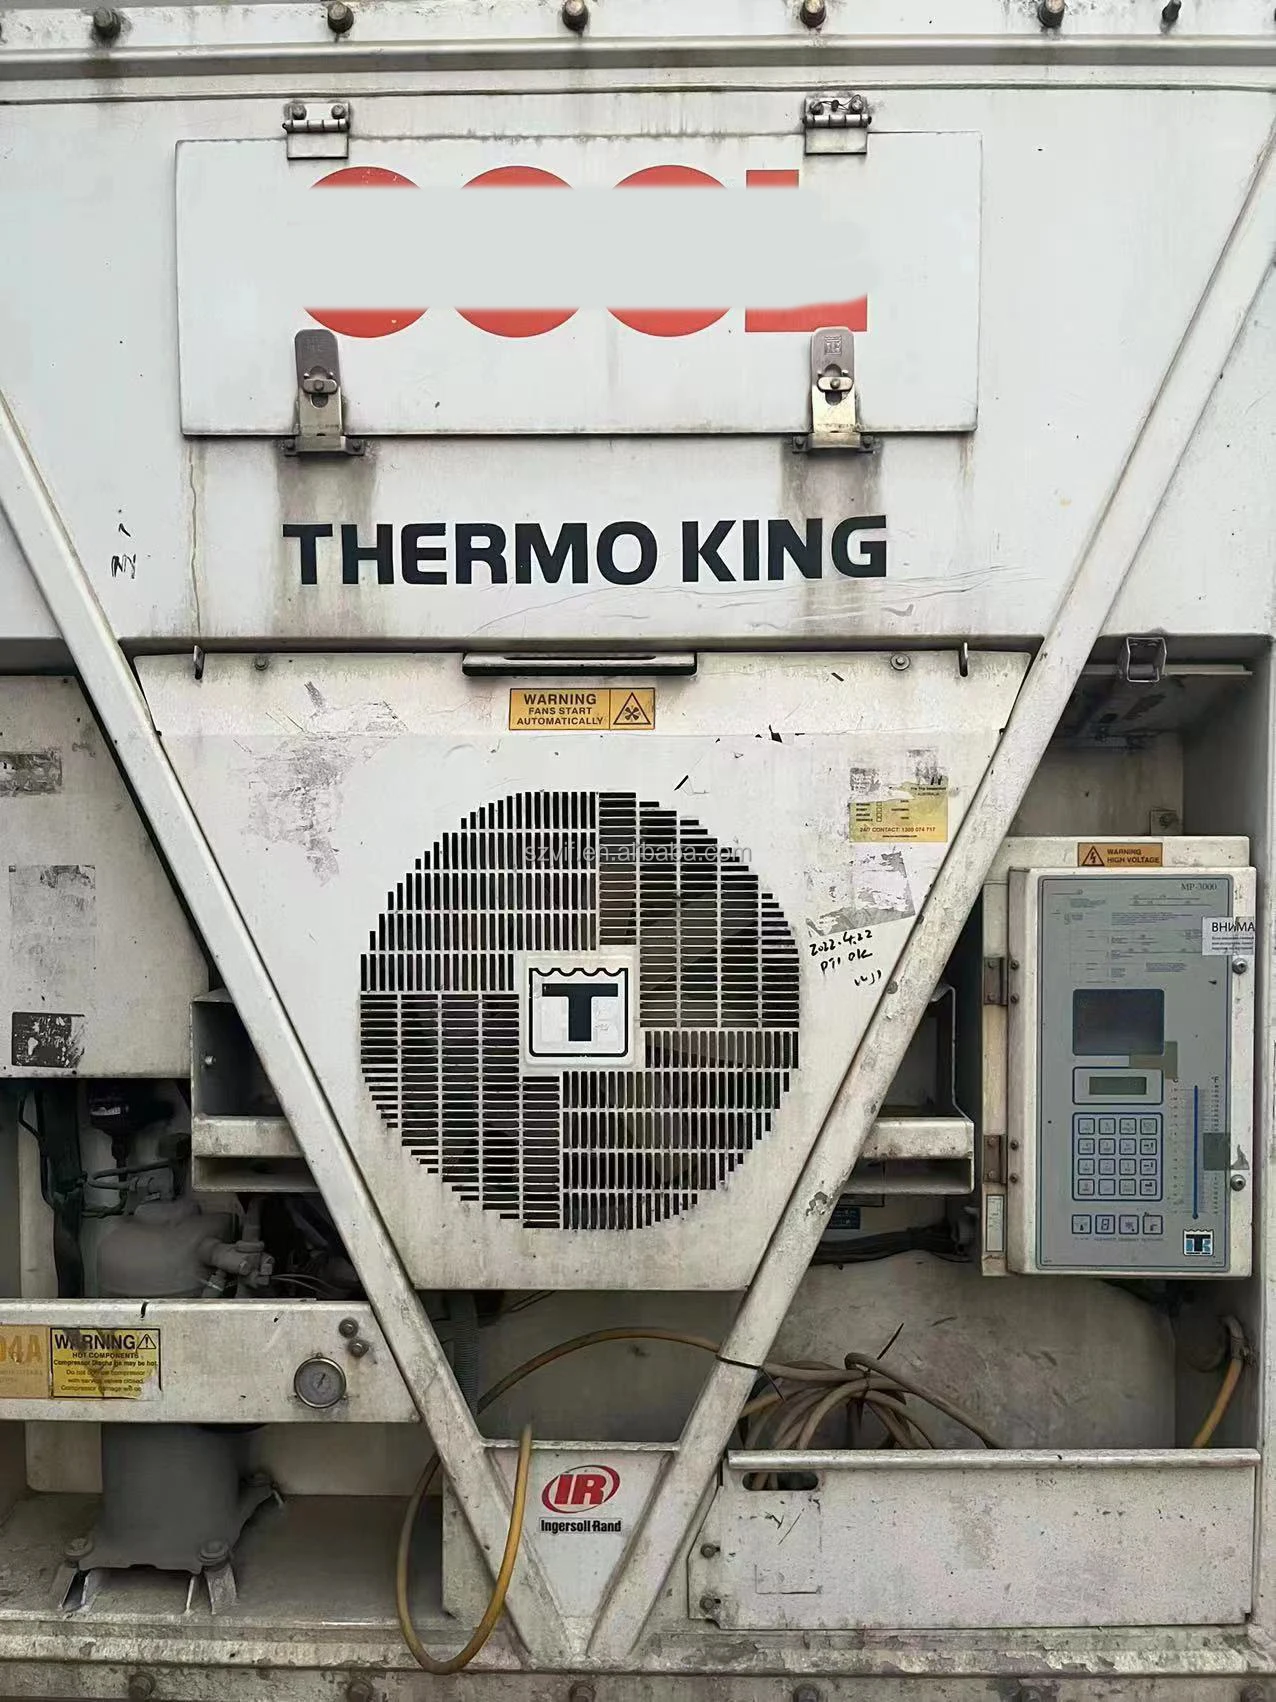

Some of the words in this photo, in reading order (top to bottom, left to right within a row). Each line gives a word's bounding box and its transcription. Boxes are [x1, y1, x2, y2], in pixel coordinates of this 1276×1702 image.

[283, 521, 657, 585] THERMO
[682, 514, 887, 582] KING
[523, 693, 597, 705] WARNING
[528, 707, 556, 715] FANS
[558, 707, 592, 715] START
[516, 717, 604, 725] AUTOMATICALLY
[1107, 848, 1142, 856] WARNING
[542, 983, 618, 1041] T
[54, 1333, 136, 1350] WRNING
[554, 1474, 607, 1505] IR
